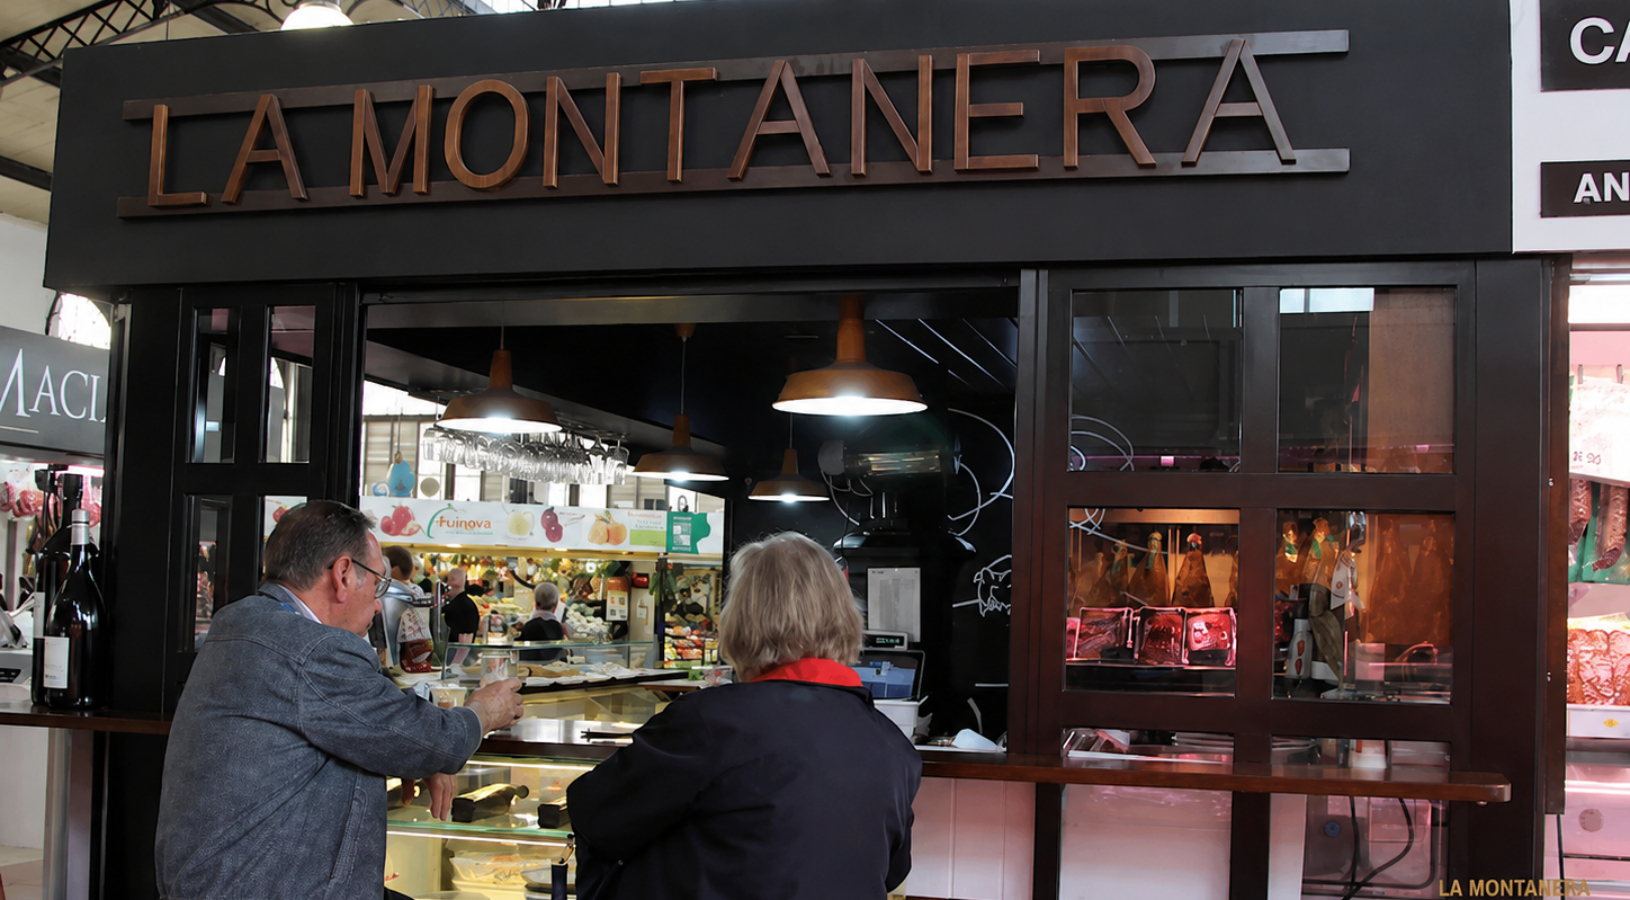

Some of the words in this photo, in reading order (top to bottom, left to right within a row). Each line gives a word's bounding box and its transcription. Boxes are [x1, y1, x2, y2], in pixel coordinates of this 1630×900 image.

[148, 93, 309, 207] LA
[349, 38, 1297, 197] MONTANERA
[1573, 171, 1630, 204] AN
